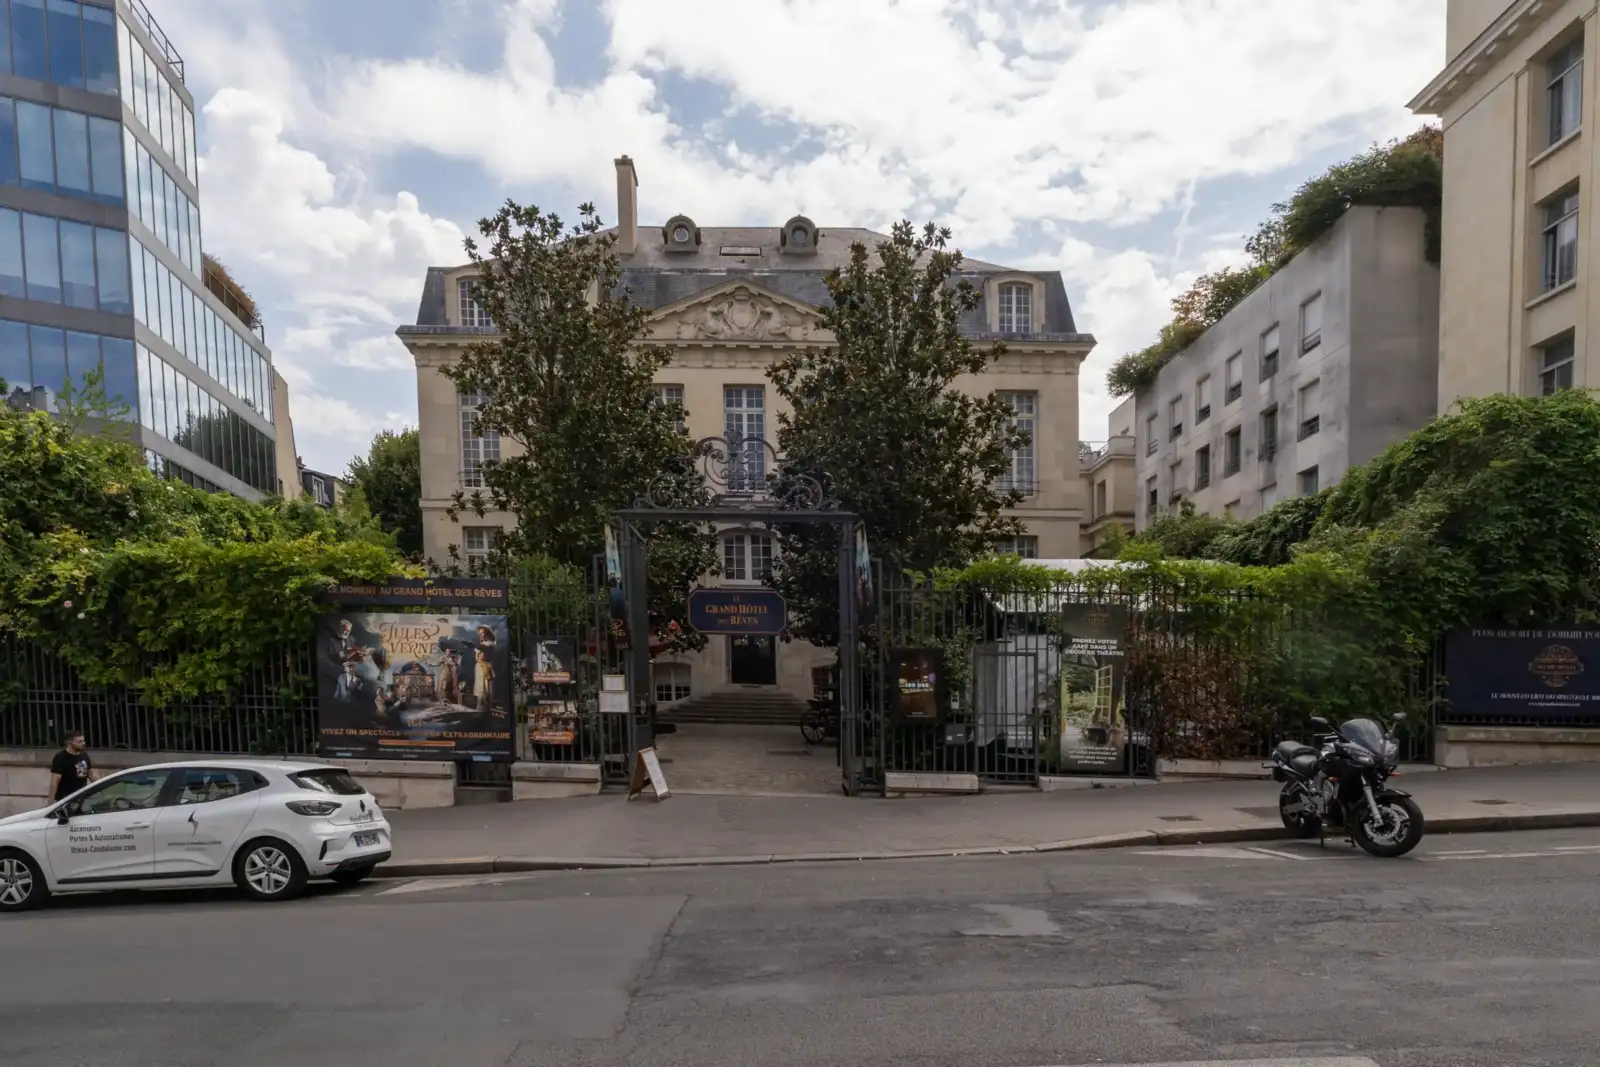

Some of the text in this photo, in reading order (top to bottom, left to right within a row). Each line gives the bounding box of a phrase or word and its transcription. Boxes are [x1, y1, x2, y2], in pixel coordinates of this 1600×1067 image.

[379, 587, 391, 595] AU
[393, 587, 423, 596] GRAND
[426, 586, 452, 596] HÔTEL
[456, 588, 472, 597] DES
[474, 586, 502, 598] RÊVES
[705, 604, 737, 613] GRAND
[379, 621, 440, 641] JULES
[390, 640, 439, 660] VERNE
[321, 728, 344, 736] VIVEZ
[443, 731, 511, 739] EXTRAORDINAIRE
[69, 825, 101, 833] Ascenseurs
[69, 835, 88, 843] Portes
